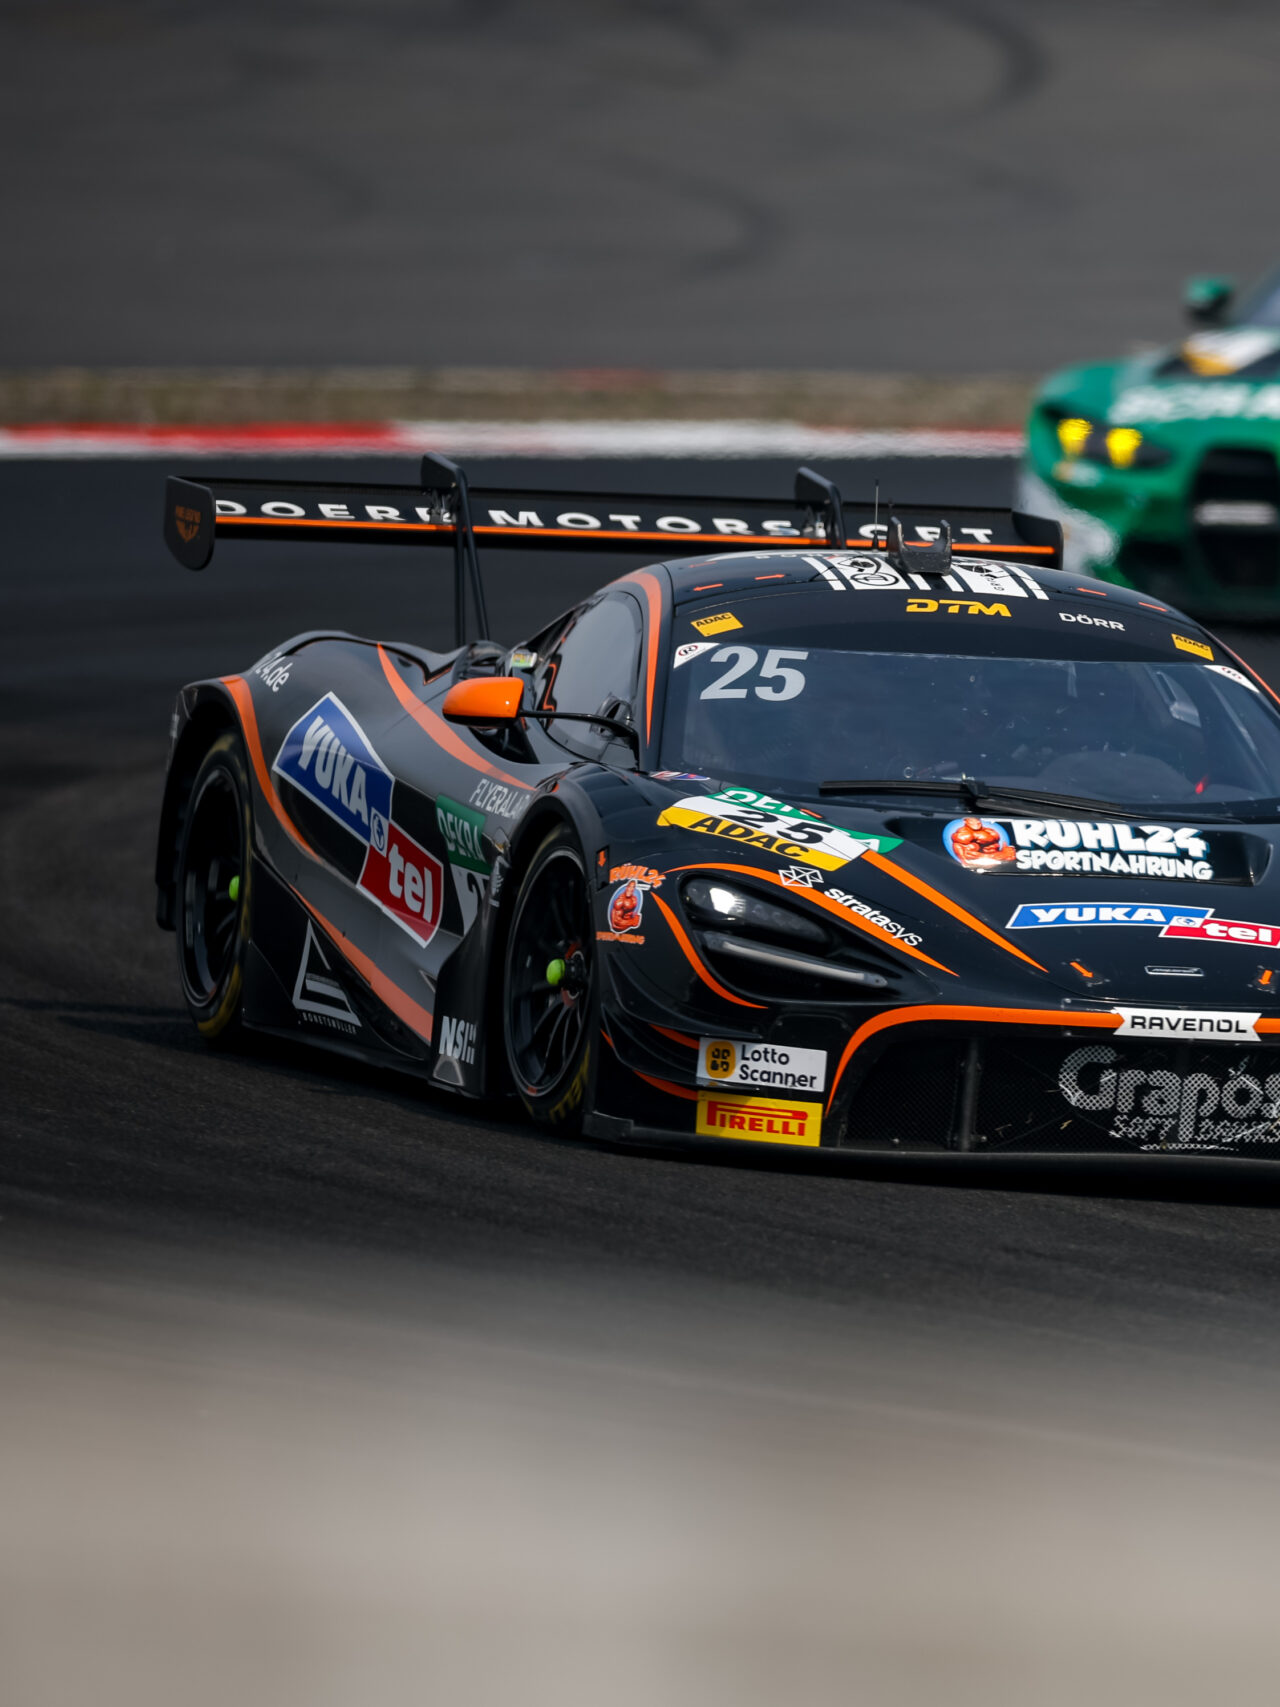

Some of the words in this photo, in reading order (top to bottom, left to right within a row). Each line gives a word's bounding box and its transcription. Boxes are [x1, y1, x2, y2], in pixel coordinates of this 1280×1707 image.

[488, 510, 993, 543] MOTORSORT
[695, 613, 732, 627] ADAC
[906, 598, 1012, 617] DTM
[1059, 612, 1125, 631] DÖRR
[700, 646, 809, 701] 25
[298, 715, 369, 826] YUKA
[437, 807, 486, 863] DEKRA
[688, 817, 809, 857] ADAC
[714, 790, 880, 852] DEA
[718, 810, 824, 844] 25
[1016, 850, 1214, 880] SPORTNAHRUNG
[388, 842, 433, 923] tel
[824, 888, 923, 947] stratasys
[1030, 908, 1167, 923] YUKA
[1203, 922, 1273, 942] tel
[1131, 1015, 1248, 1034] RAVENOL
[741, 1044, 790, 1065] Lotto
[739, 1064, 817, 1088] Scanner
[706, 1100, 808, 1136] PIRELLI
